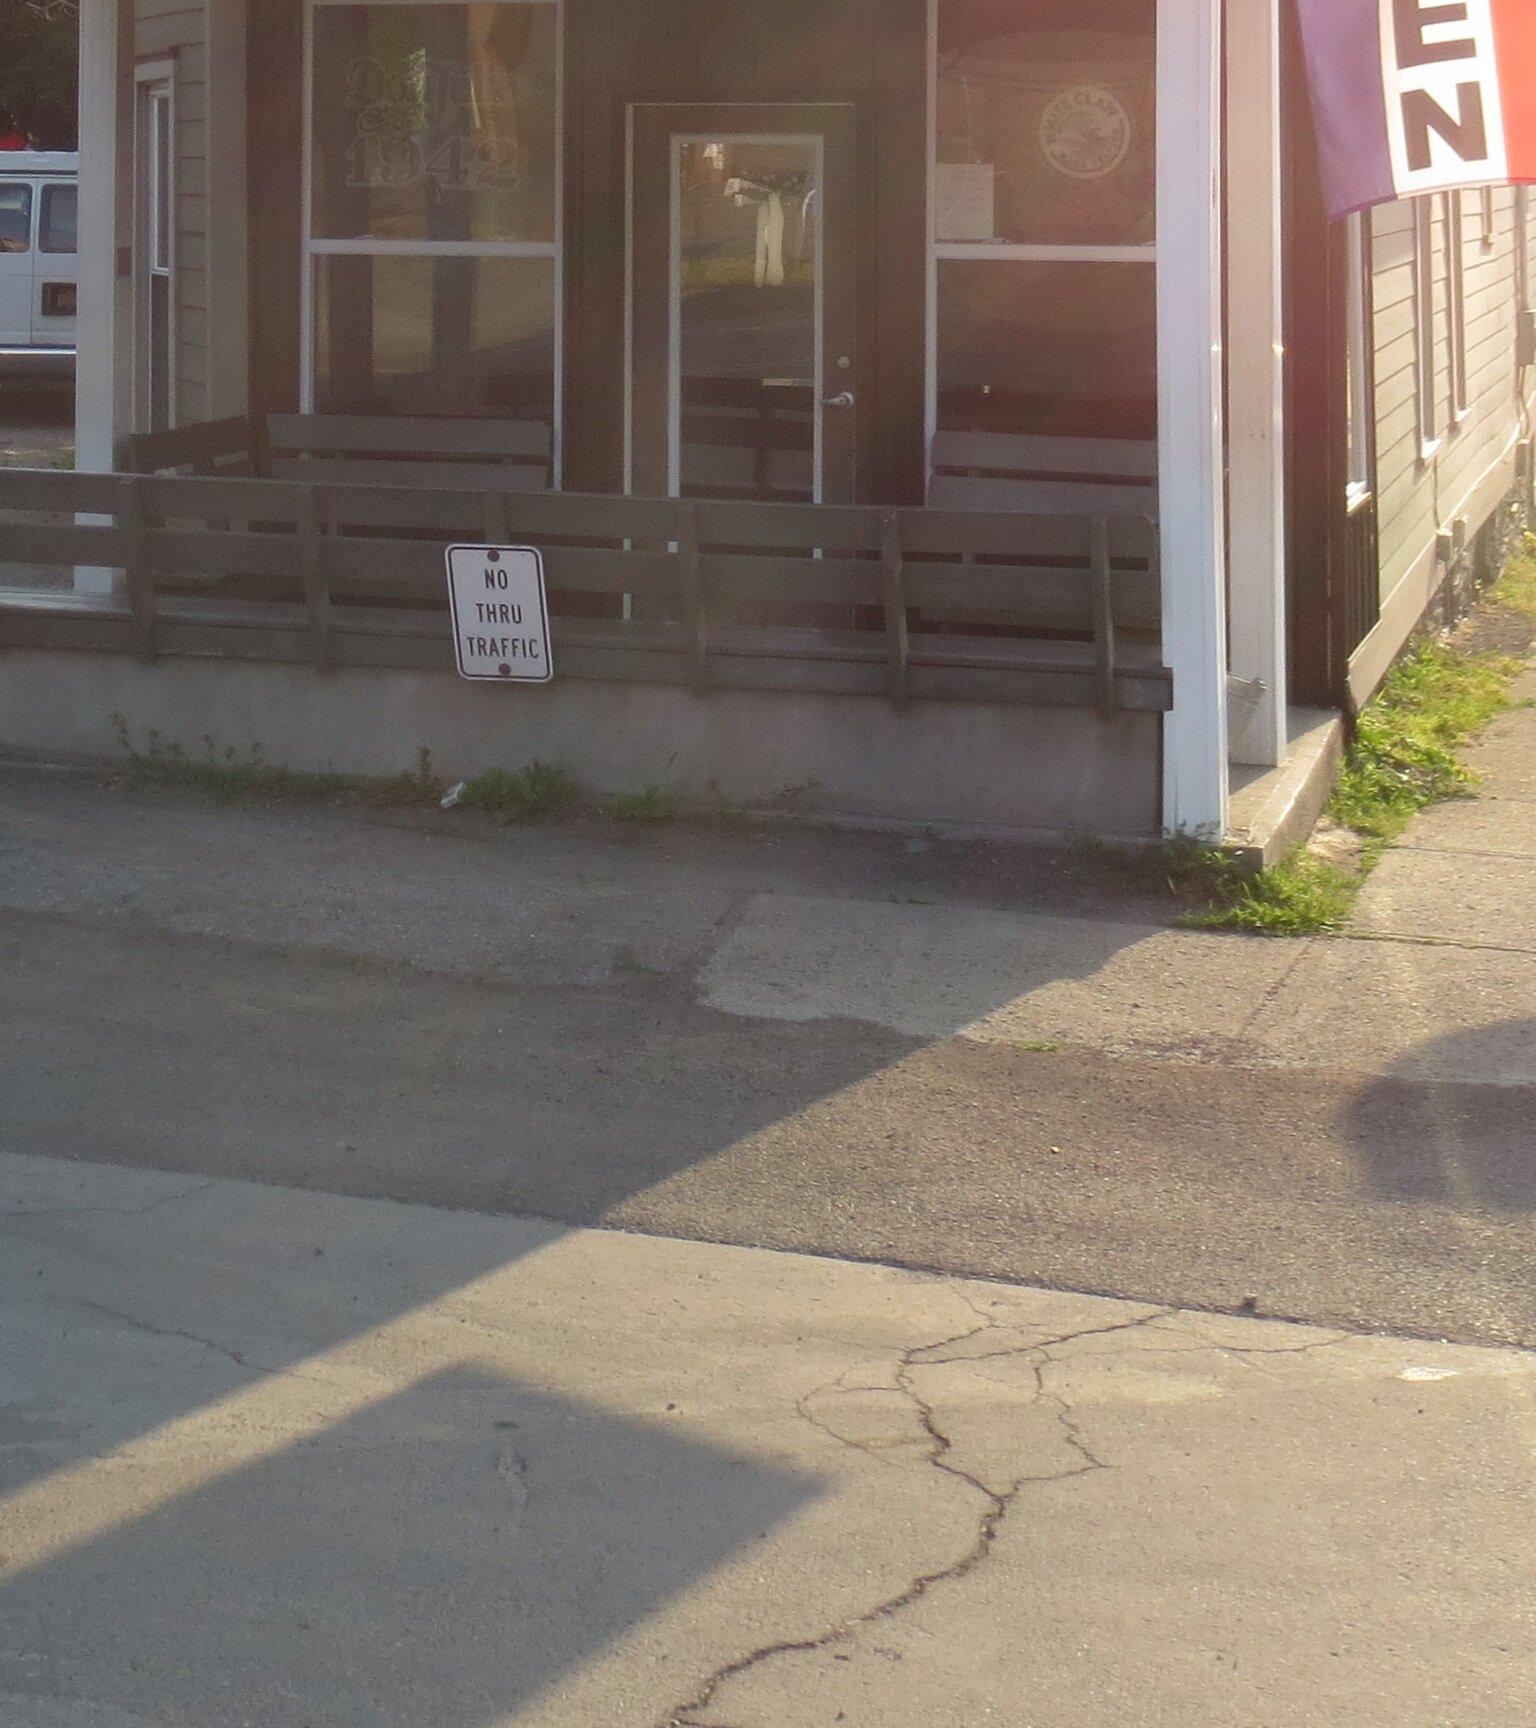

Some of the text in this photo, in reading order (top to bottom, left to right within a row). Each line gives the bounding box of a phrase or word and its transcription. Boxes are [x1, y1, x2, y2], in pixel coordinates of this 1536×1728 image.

[1074, 92, 1120, 117] CLAW
[484, 569, 509, 590] NO
[475, 603, 523, 624] THRU
[466, 636, 540, 660] TRAFFIC
